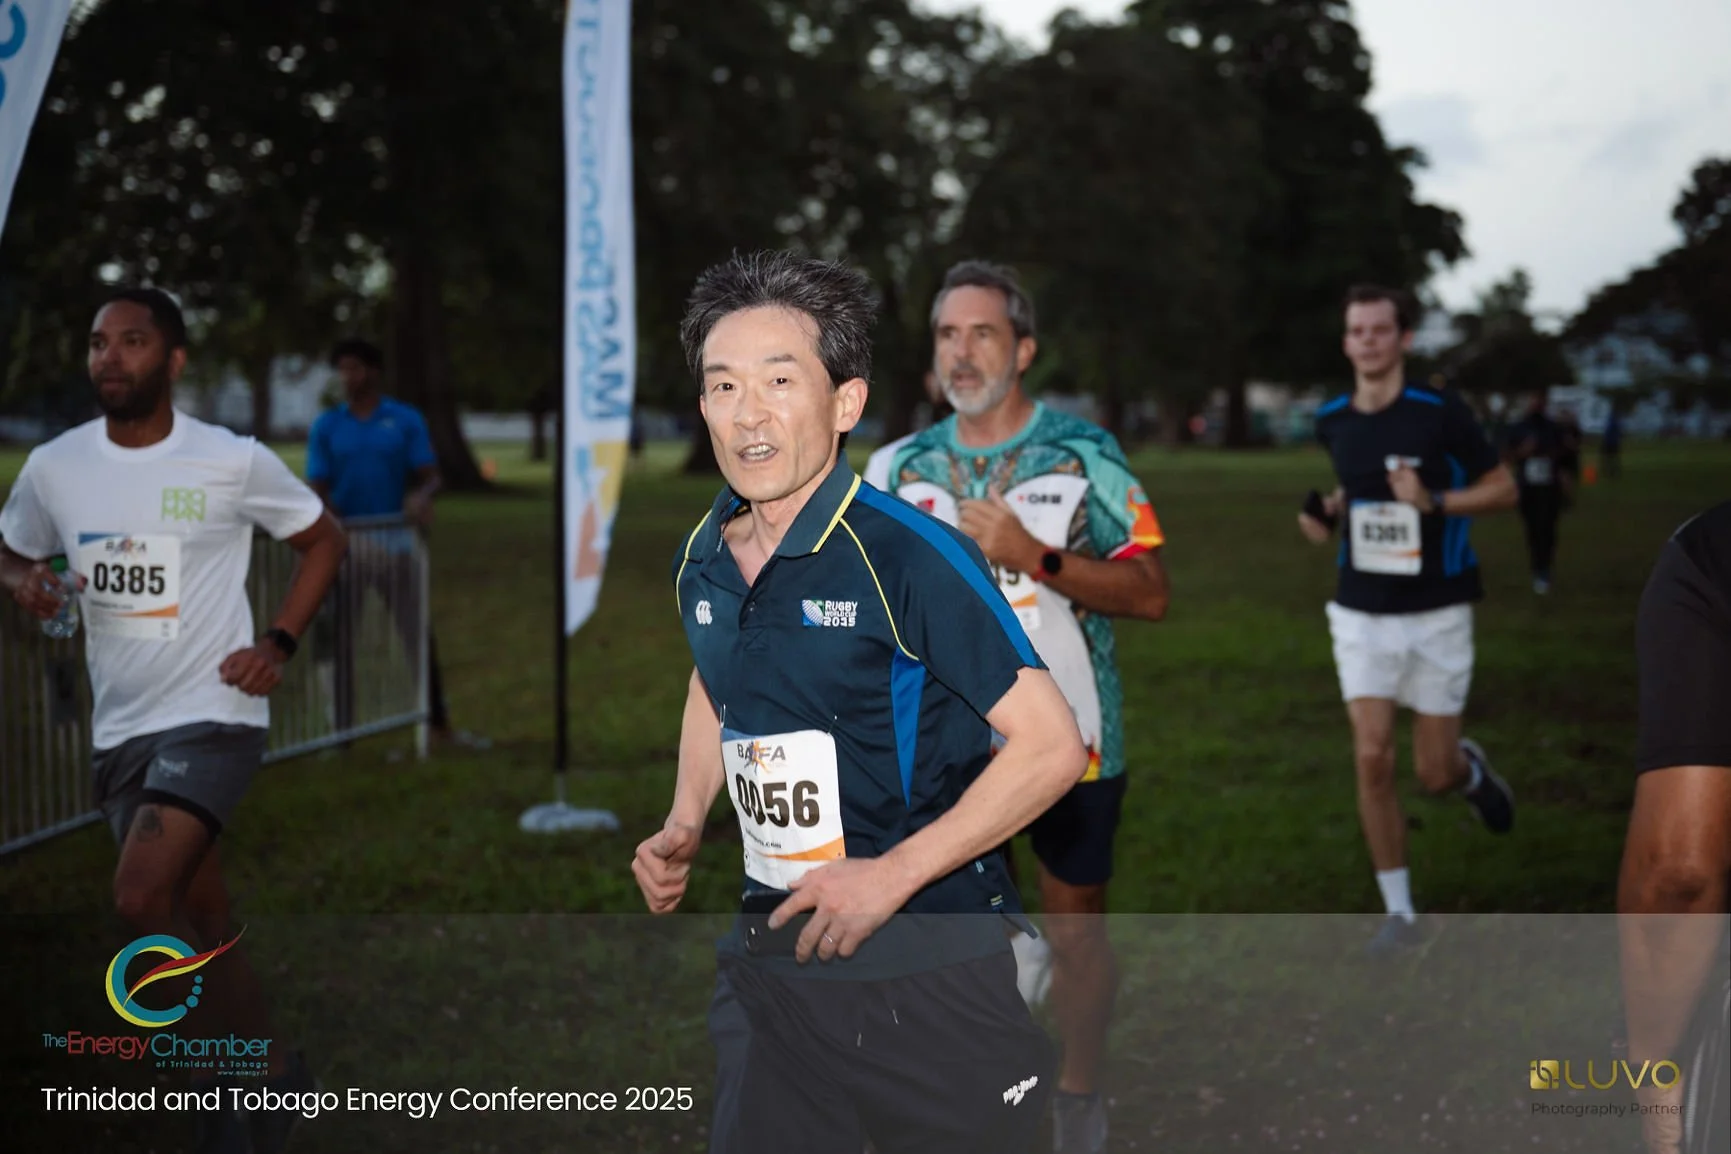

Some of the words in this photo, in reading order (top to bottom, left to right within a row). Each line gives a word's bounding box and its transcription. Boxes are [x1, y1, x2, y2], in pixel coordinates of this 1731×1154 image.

[94, 562, 166, 597] 0385
[824, 600, 858, 611] RUGBY
[736, 773, 820, 828] 0056
